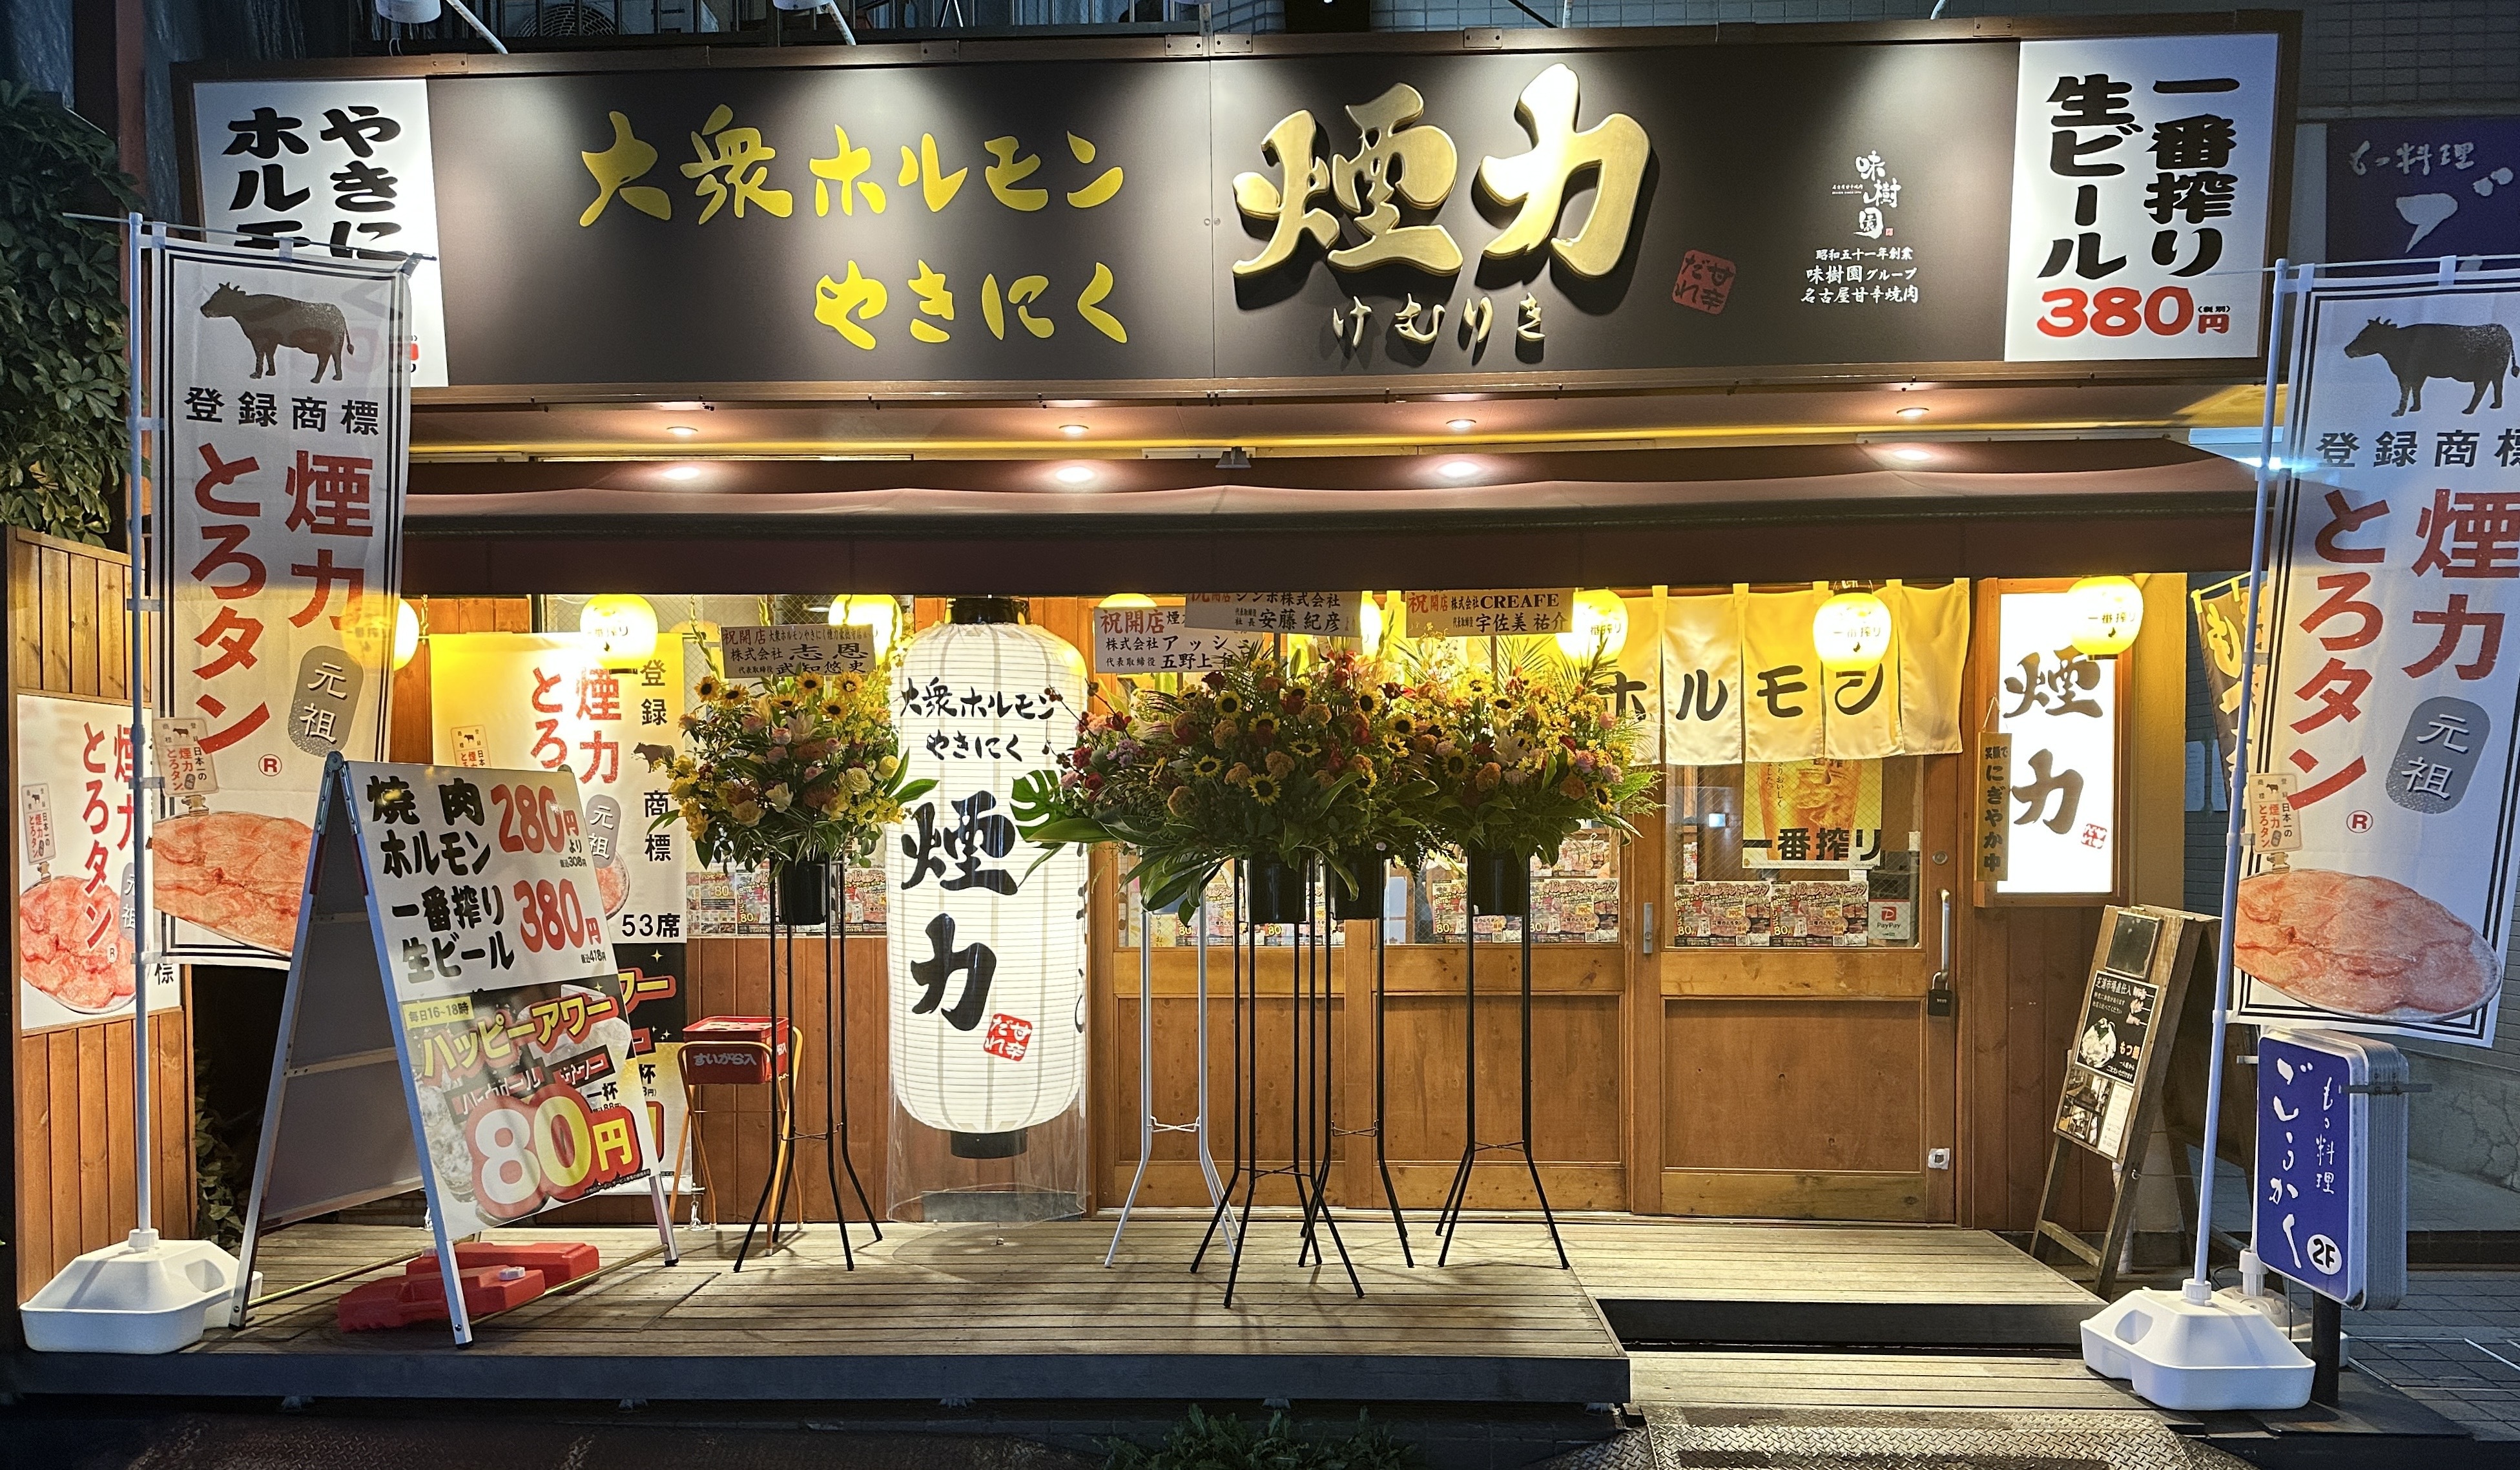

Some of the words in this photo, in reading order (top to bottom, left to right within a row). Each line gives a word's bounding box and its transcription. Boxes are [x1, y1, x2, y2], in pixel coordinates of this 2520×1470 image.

[580, 104, 1124, 227] 大衆ホルモン
[1232, 63, 1651, 278] 煙力
[2036, 74, 2144, 279] 生ビール
[2143, 78, 2240, 277] 一番搾り
[1806, 265, 1917, 284] 味樹園グループ
[1815, 247, 1914, 260] 昭和五十一年創業
[814, 259, 1128, 350] やきにく
[1332, 292, 1545, 349] けむりき
[1801, 285, 1919, 304] 名古屋甘辛焼肉
[184, 387, 379, 435] 登録商標
[285, 450, 373, 630] 煙力
[191, 443, 270, 754] とろタン
[1408, 592, 1448, 614] 祝開店
[1451, 595, 1479, 610] 株式会社
[1480, 593, 1559, 609] CREAFE
[2401, 488, 2520, 680] 煙力
[722, 629, 766, 645] 祝開店
[1100, 609, 1165, 634] 祝開店
[1106, 637, 1159, 651] 株式会社
[730, 647, 783, 661] 株式会社
[1106, 657, 1156, 667] 代表取締役
[2287, 490, 2390, 811] とろタン
[300, 662, 348, 744] 元祖
[900, 676, 1055, 719] 大衆ホルモン
[1597, 663, 1884, 721] ホルモン
[575, 667, 622, 784] 煙力
[926, 729, 1023, 762] やきにく
[2003, 644, 2103, 834] 煙力
[2402, 713, 2471, 800] 元祖
[82, 721, 114, 951] とろタン
[589, 803, 614, 859] 元祖
[1743, 827, 1881, 861] 一番搾り
[1983, 765, 2006, 873] にぎやか中
[2259, 804, 2270, 848] とろタン
[2282, 803, 2292, 837] 日本一の
[380, 829, 491, 879] ホルモン
[568, 838, 582, 854] より
[391, 884, 504, 933] 一番搾り
[621, 913, 681, 938] 53席
[900, 790, 1018, 1031] 煙力
[402, 930, 515, 984] 生ビール
[423, 996, 612, 1077] ハッピーアワー
[586, 1081, 619, 1101] 一杯
[2312, 1237, 2336, 1269] 2F
